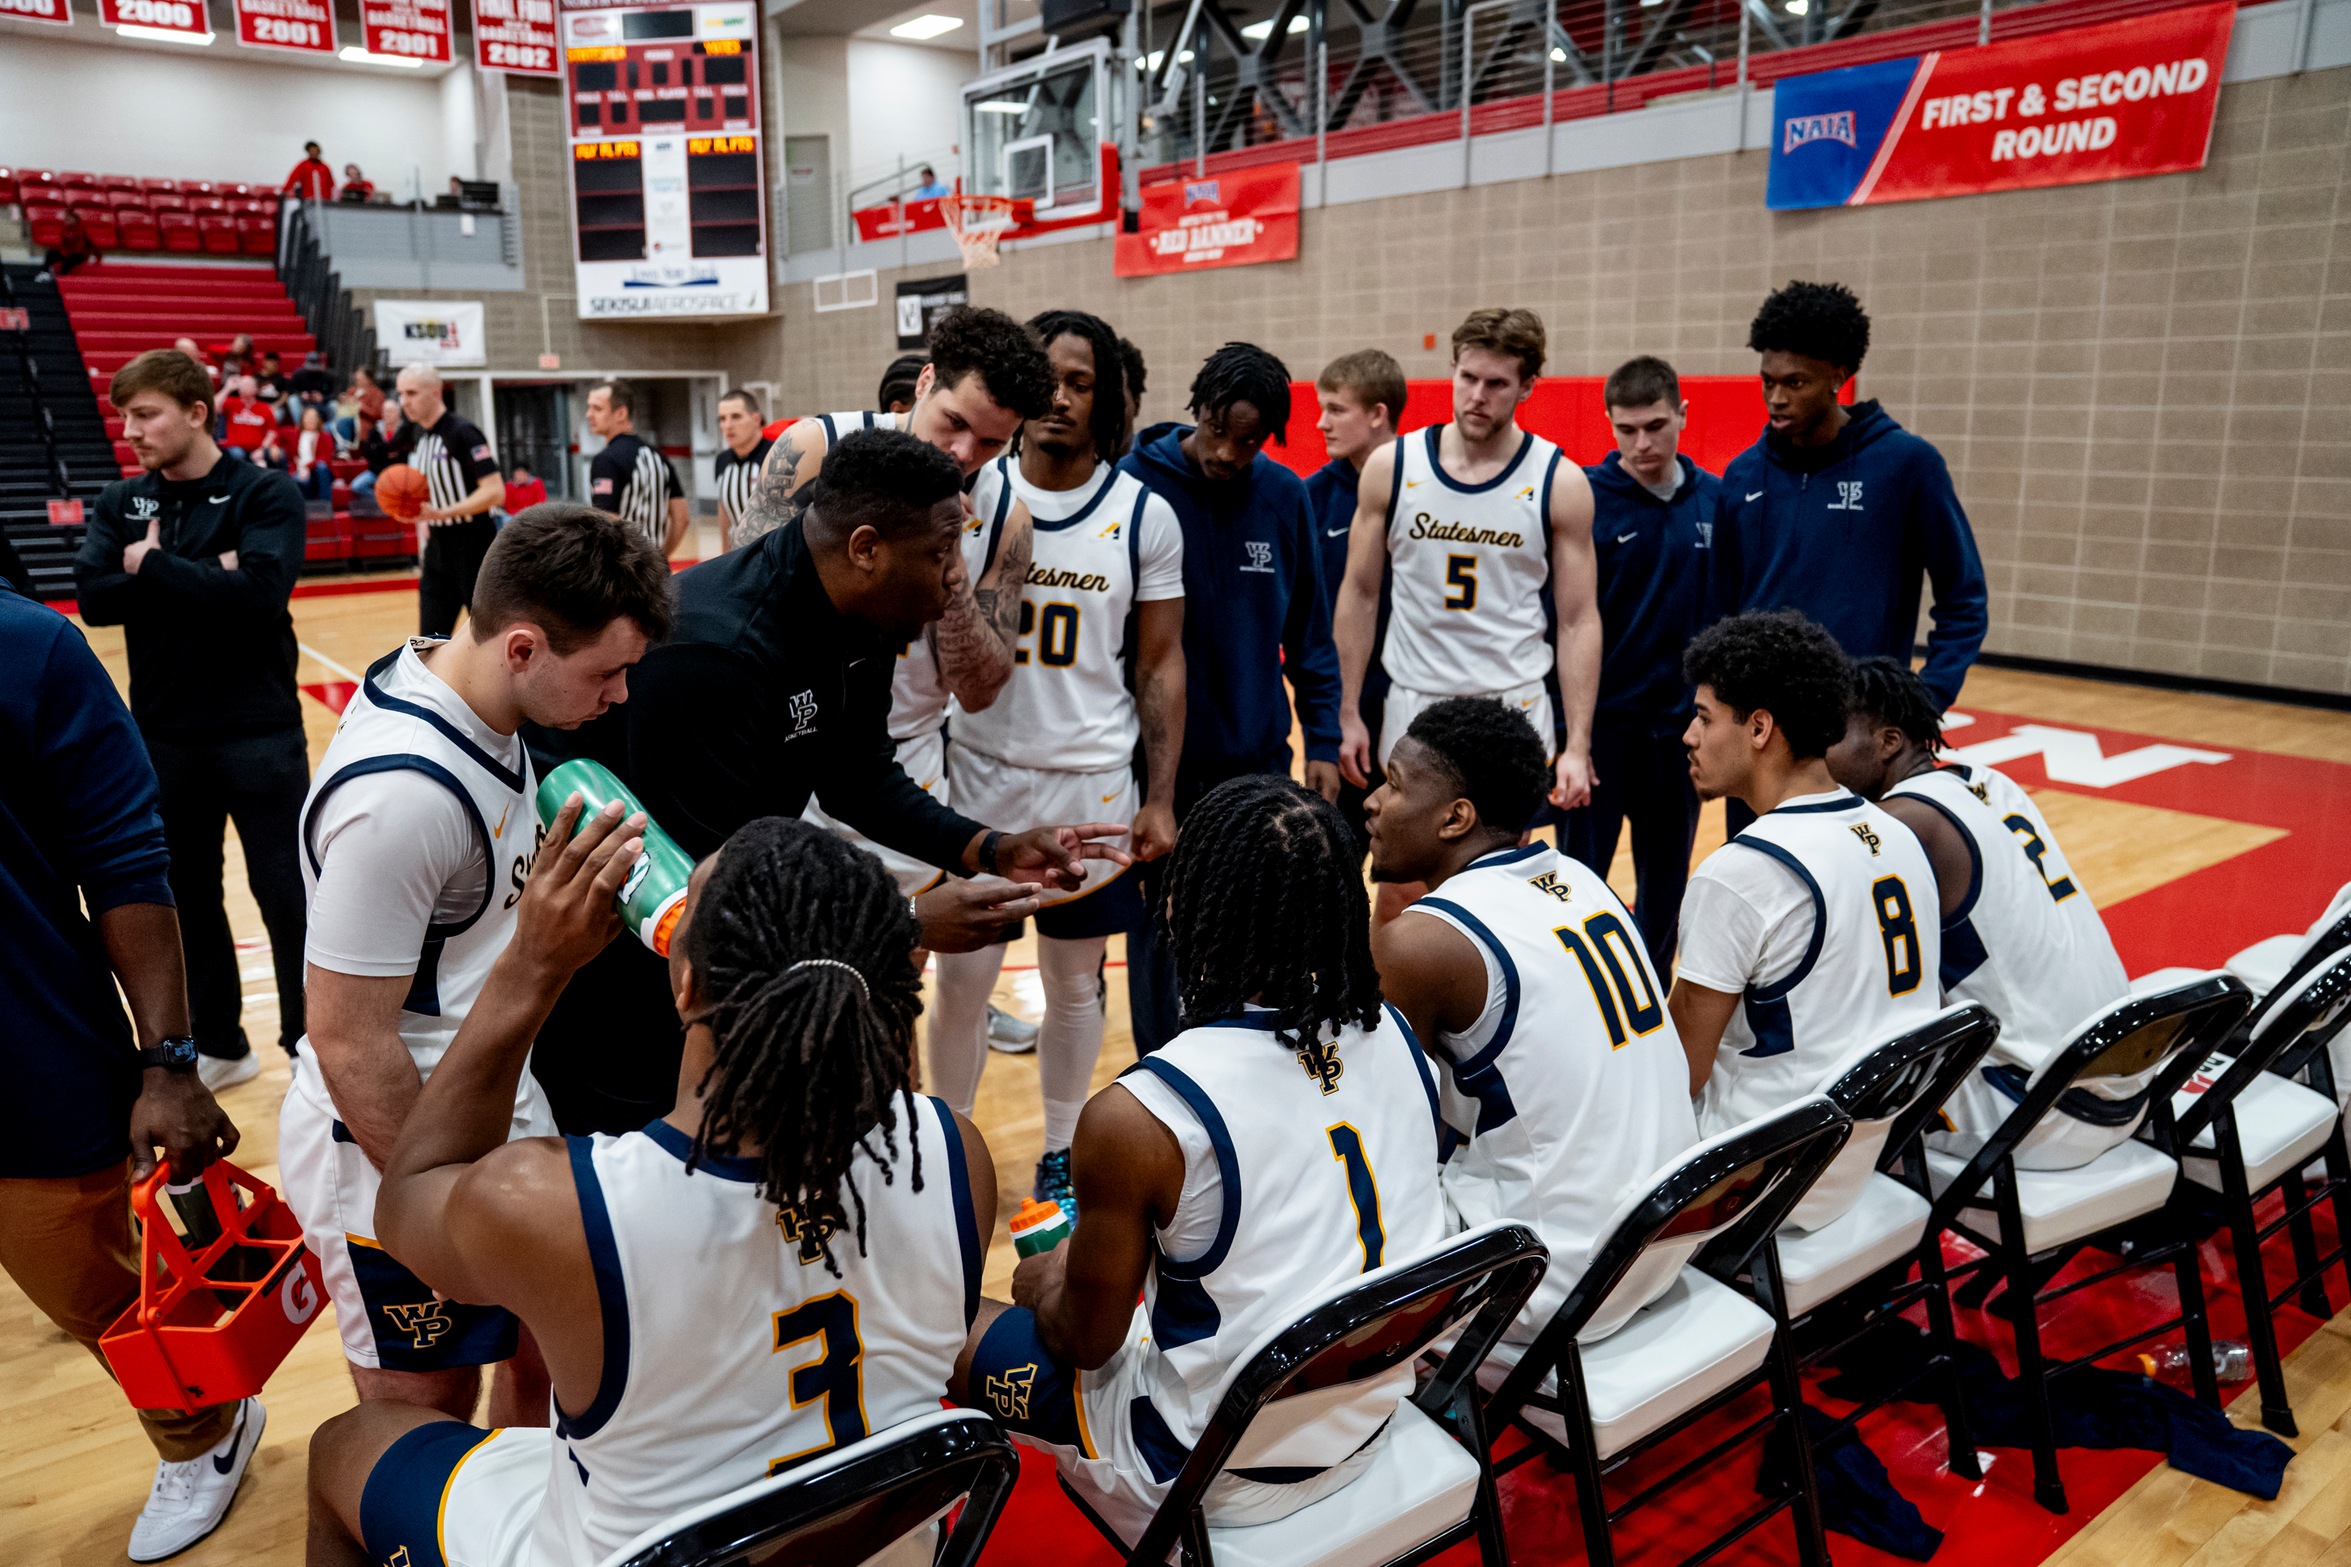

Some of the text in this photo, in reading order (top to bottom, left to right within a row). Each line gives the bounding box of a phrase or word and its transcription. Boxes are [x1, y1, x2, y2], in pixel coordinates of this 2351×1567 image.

[116, 0, 194, 27] 2000
[254, 17, 321, 47] 2001
[379, 30, 438, 57] 2001
[487, 42, 551, 69] 2002
[1921, 57, 2209, 129] FIRST & SECOND
[1783, 110, 1857, 154] NAIA
[1991, 118, 2117, 161] ROUND
[1409, 512, 1524, 548] Statesmen
[1024, 561, 1110, 593] tesmen
[1444, 553, 1478, 612] 5
[789, 689, 818, 730] WP
[1848, 822, 1881, 857] WP
[2001, 812, 2079, 905] 2
[1528, 870, 1572, 903] WP
[1872, 873, 1923, 999] 8
[1551, 909, 1665, 1051] 10
[1325, 1120, 1387, 1275] 1
[281, 1259, 318, 1325] G
[383, 1301, 452, 1349] WP
[765, 1288, 872, 1480] 3
[986, 1363, 1039, 1420] WP
